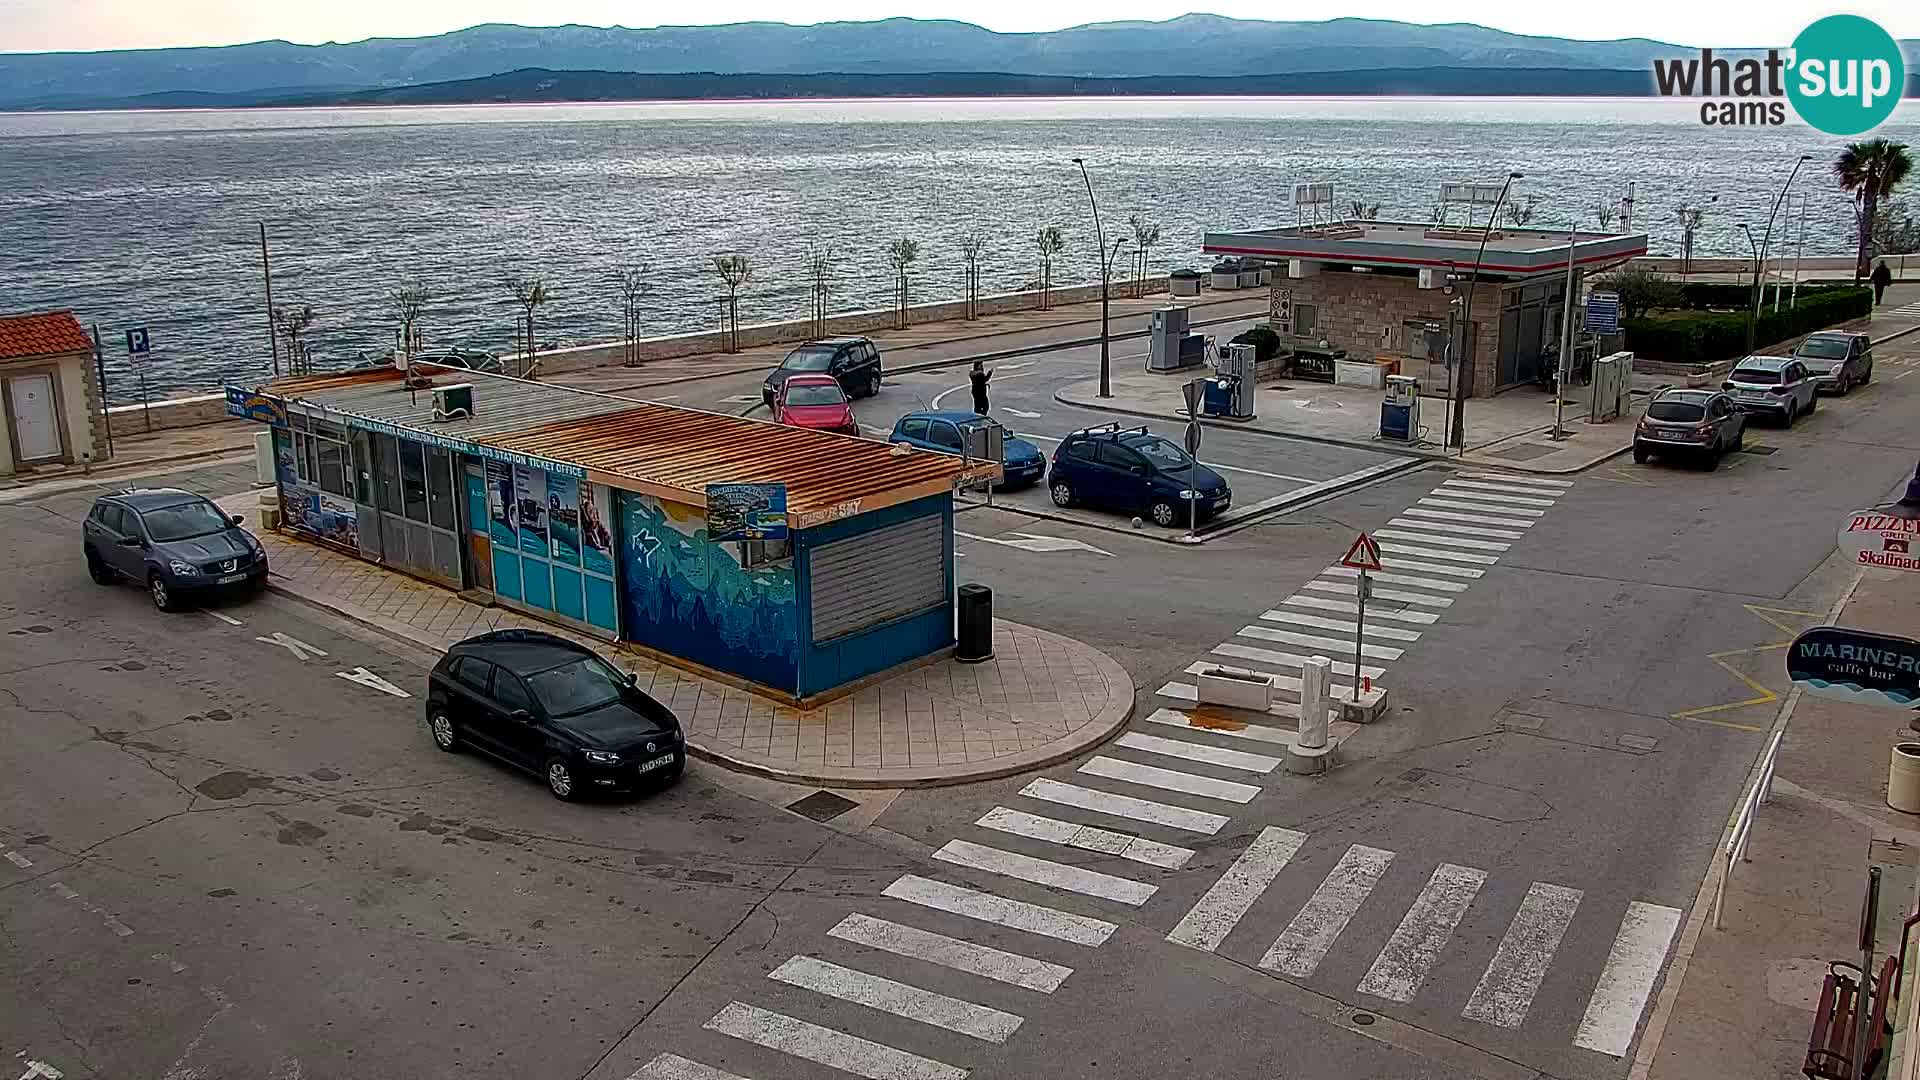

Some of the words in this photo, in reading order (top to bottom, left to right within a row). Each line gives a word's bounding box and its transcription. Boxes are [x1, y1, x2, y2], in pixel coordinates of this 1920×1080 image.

[131, 331, 144, 350] P
[437, 435, 469, 452] POSTAJA
[479, 446, 493, 458] BUS
[495, 449, 527, 465] STATION
[528, 457, 555, 471] TICKET
[556, 462, 583, 477] OFFICE
[1828, 663, 1865, 675] caffe
[1869, 666, 1896, 681] bar
